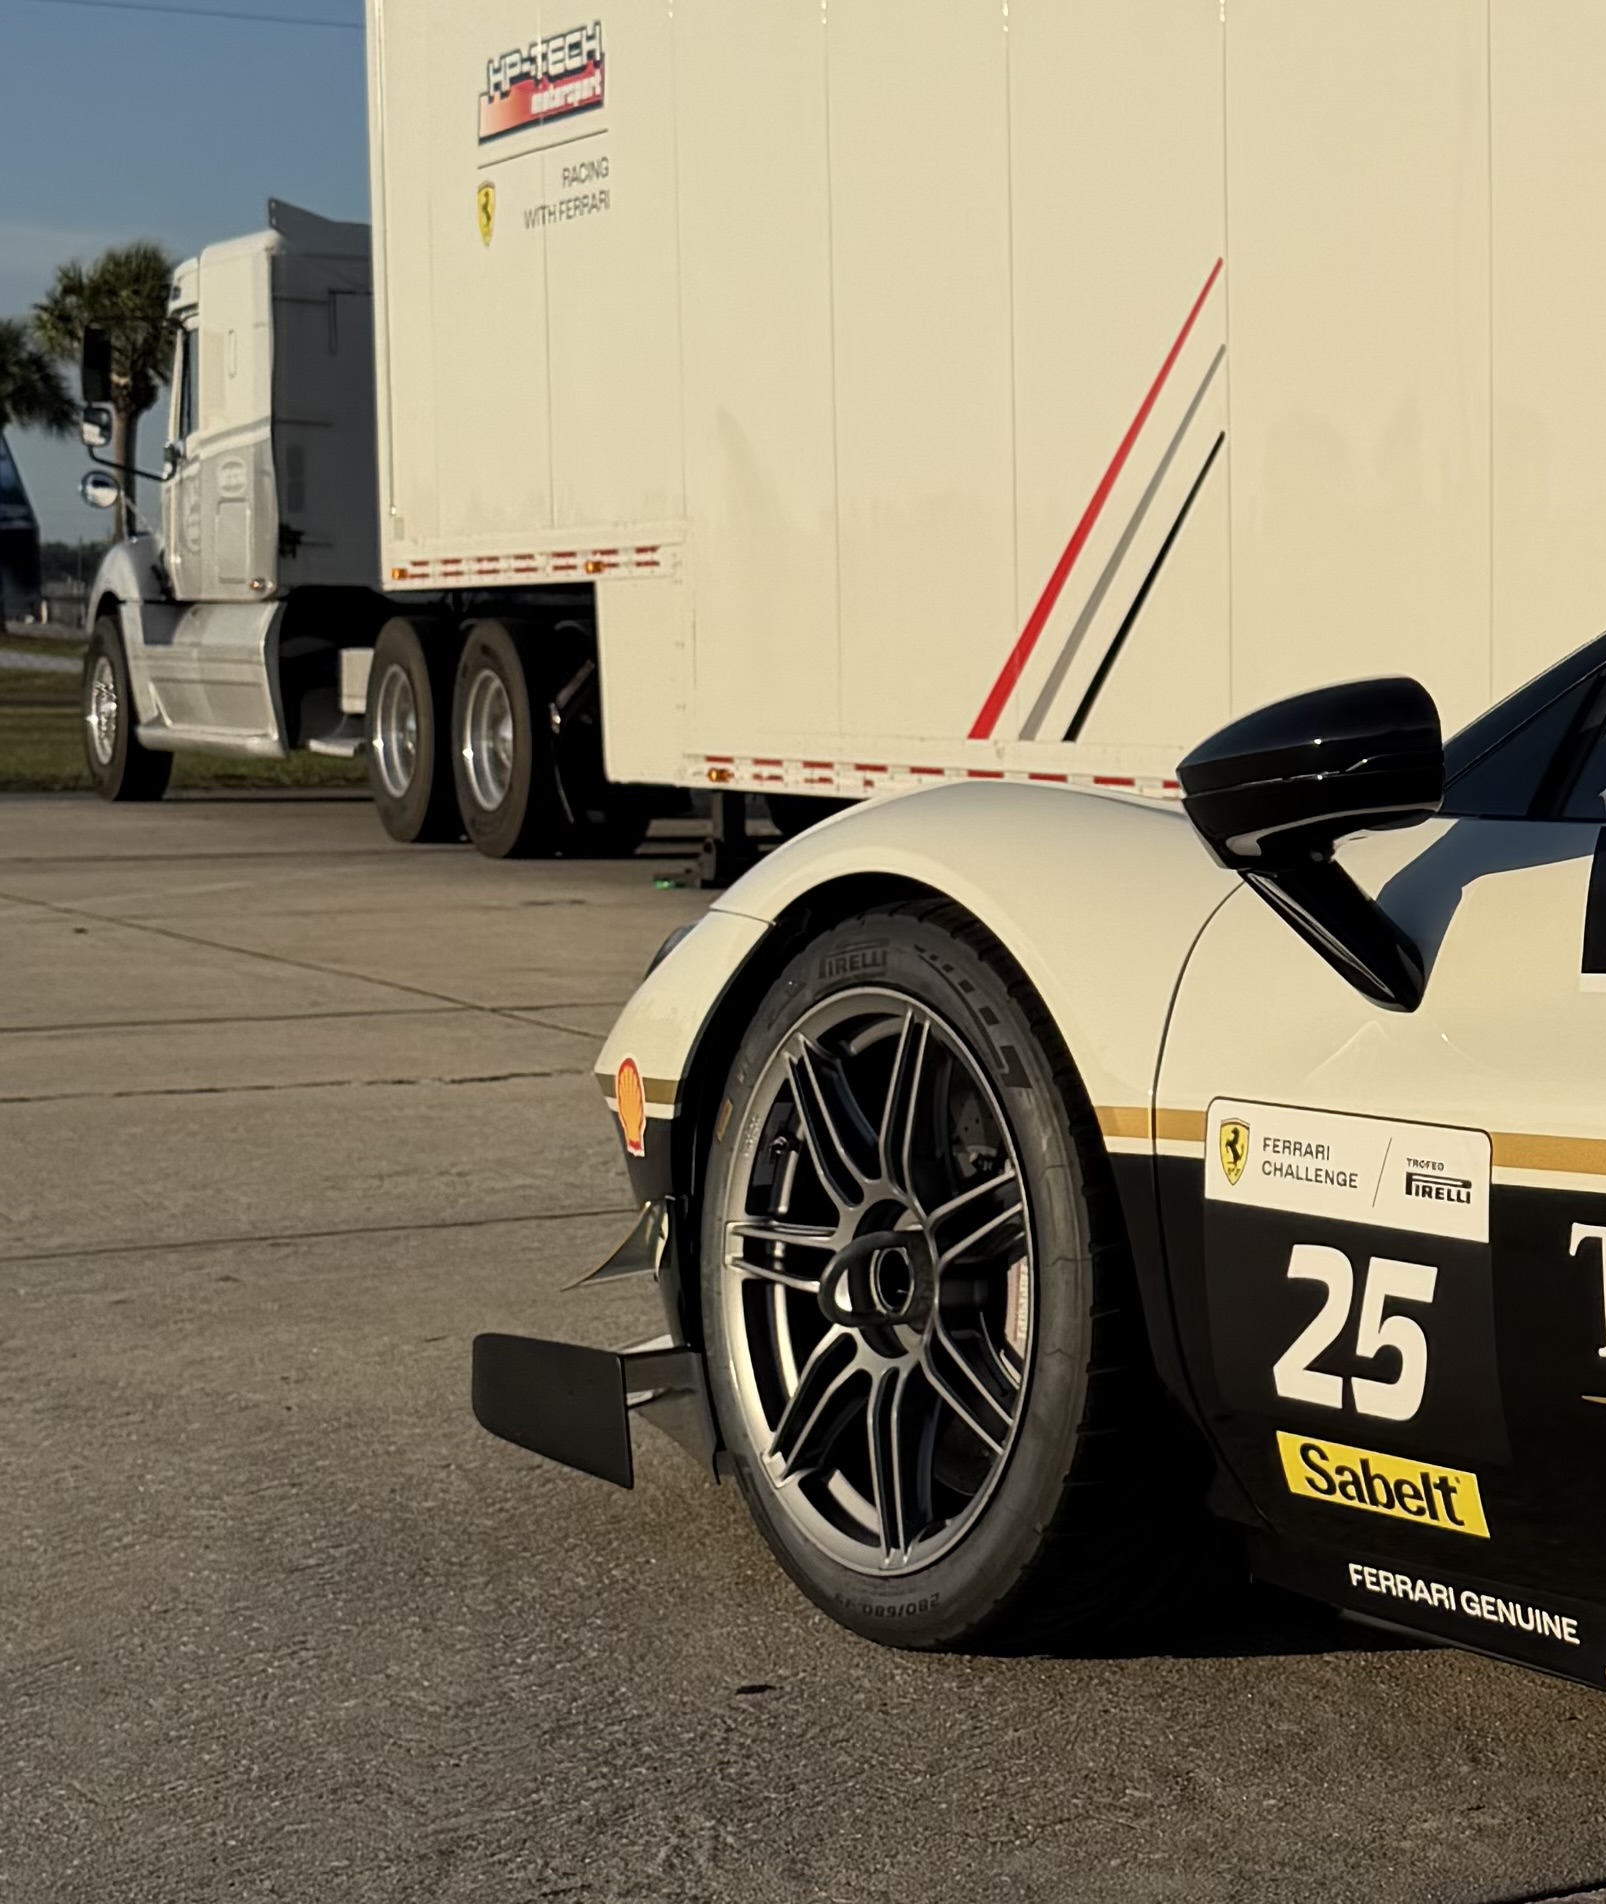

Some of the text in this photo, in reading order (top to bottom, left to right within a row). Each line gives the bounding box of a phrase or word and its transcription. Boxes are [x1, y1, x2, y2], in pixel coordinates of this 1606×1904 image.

[562, 156, 609, 188] RACING
[524, 190, 610, 230] WITH FERRARI
[818, 936, 890, 979] PIRELLI
[1262, 1135, 1332, 1162] FERRARI
[1406, 1157, 1445, 1172] TROFEO
[1261, 1160, 1359, 1190] CHALLENGE
[1405, 1171, 1472, 1205] PIRELLI
[1273, 1244, 1438, 1422] 25
[1299, 1442, 1466, 1527] Sabelt
[1348, 1562, 1581, 1646] FERRARI GENUINE
